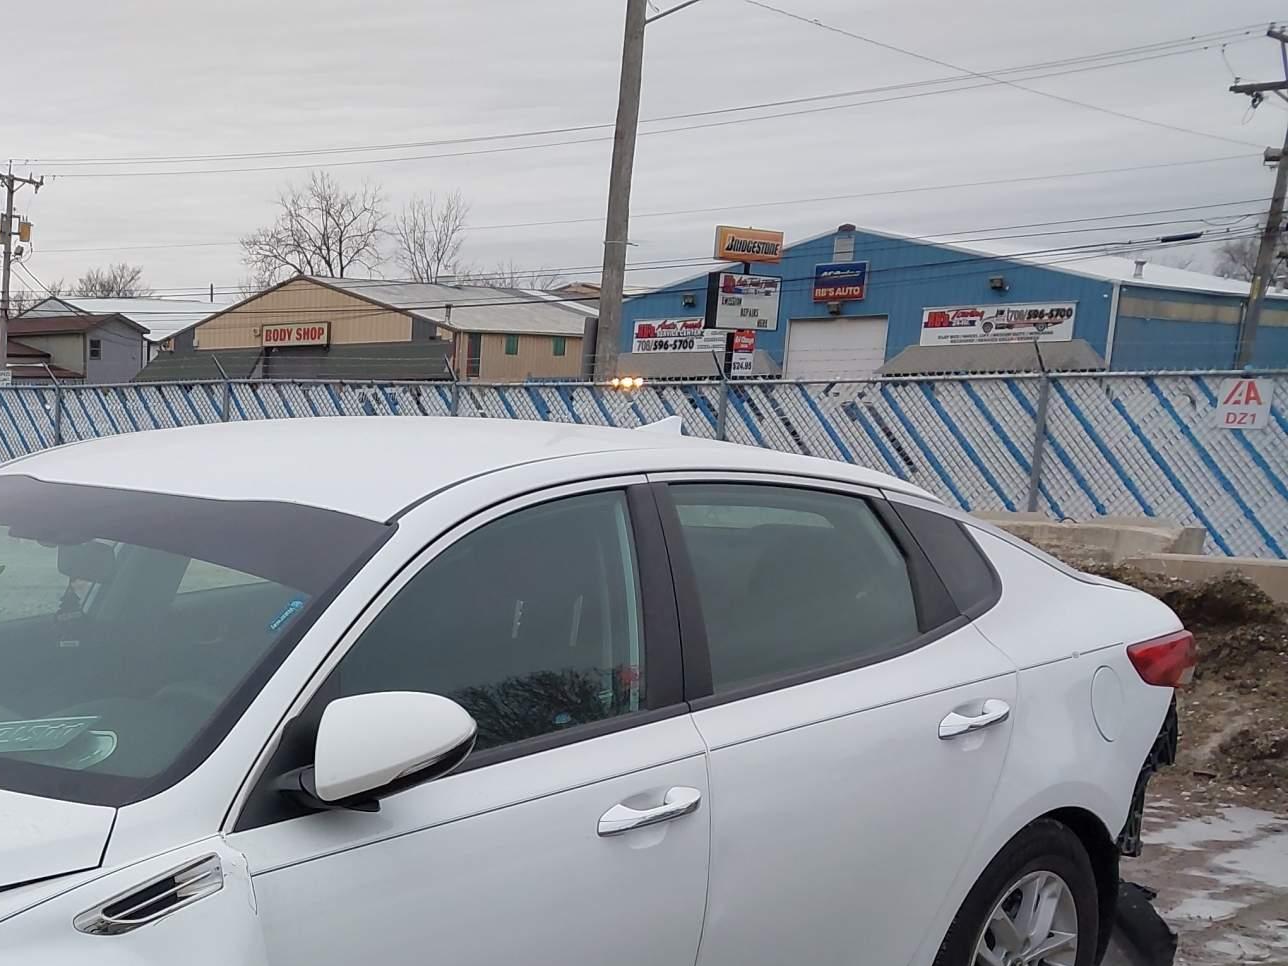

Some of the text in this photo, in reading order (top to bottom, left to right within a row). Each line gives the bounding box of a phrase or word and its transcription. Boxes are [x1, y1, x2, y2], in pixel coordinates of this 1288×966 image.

[725, 235, 779, 255] BRIDGESTONE
[834, 286, 861, 296] AUTO
[740, 307, 759, 318] REPAIRS
[265, 326, 325, 342] BODY SHOP
[1224, 411, 1257, 425] DZ1
